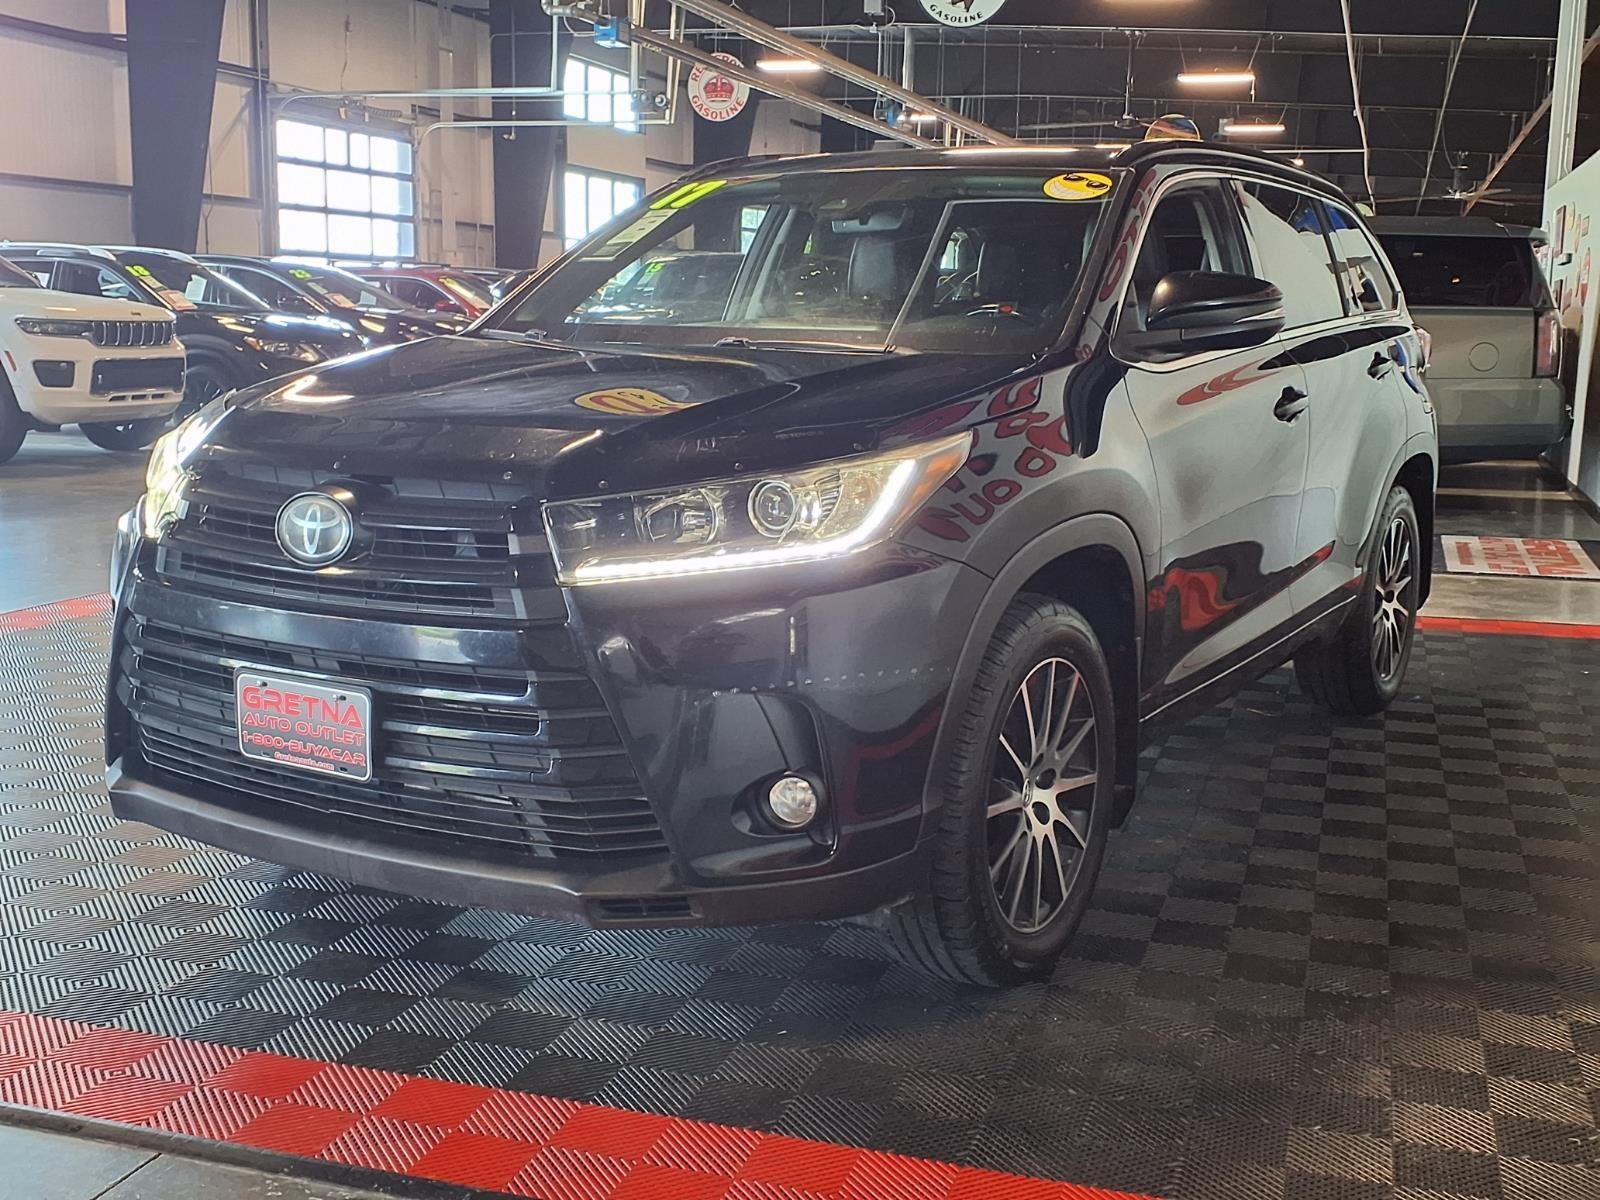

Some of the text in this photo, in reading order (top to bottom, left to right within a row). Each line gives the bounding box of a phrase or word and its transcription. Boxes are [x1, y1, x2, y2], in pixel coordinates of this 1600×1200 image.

[929, 4, 984, 23] GASOLINE
[691, 95, 744, 119] GASOLINE
[243, 686, 362, 727] GRETNA
[243, 712, 364, 744] AUTO OUTLET
[243, 731, 365, 766] 1-800-BUYACAR
